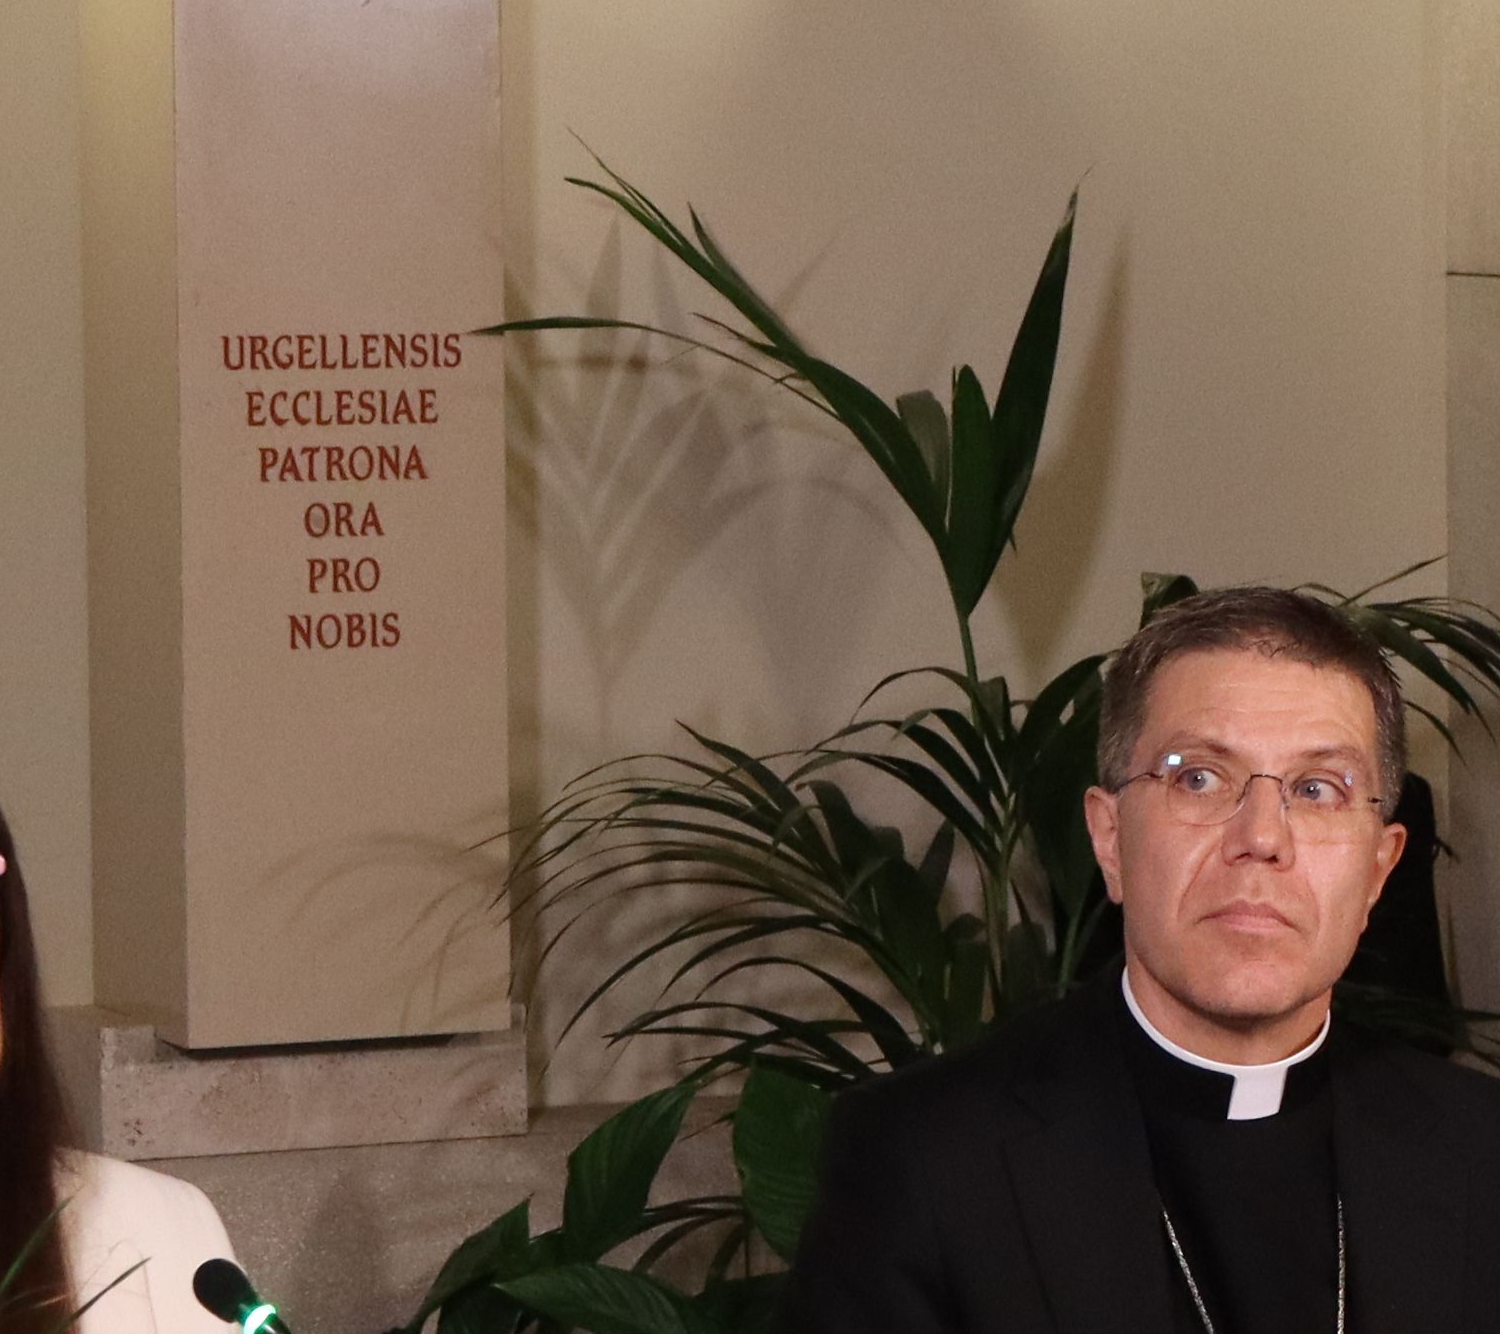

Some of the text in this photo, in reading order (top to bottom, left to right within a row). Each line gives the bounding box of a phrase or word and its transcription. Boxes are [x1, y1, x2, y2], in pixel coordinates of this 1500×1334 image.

[221, 333, 462, 371] URGELLENSIS
[245, 388, 439, 427] ECCLESIAE
[258, 444, 429, 483] PATRONA
[303, 500, 385, 538] ORA
[306, 556, 381, 594] PRO
[288, 612, 401, 650] NOBIS
